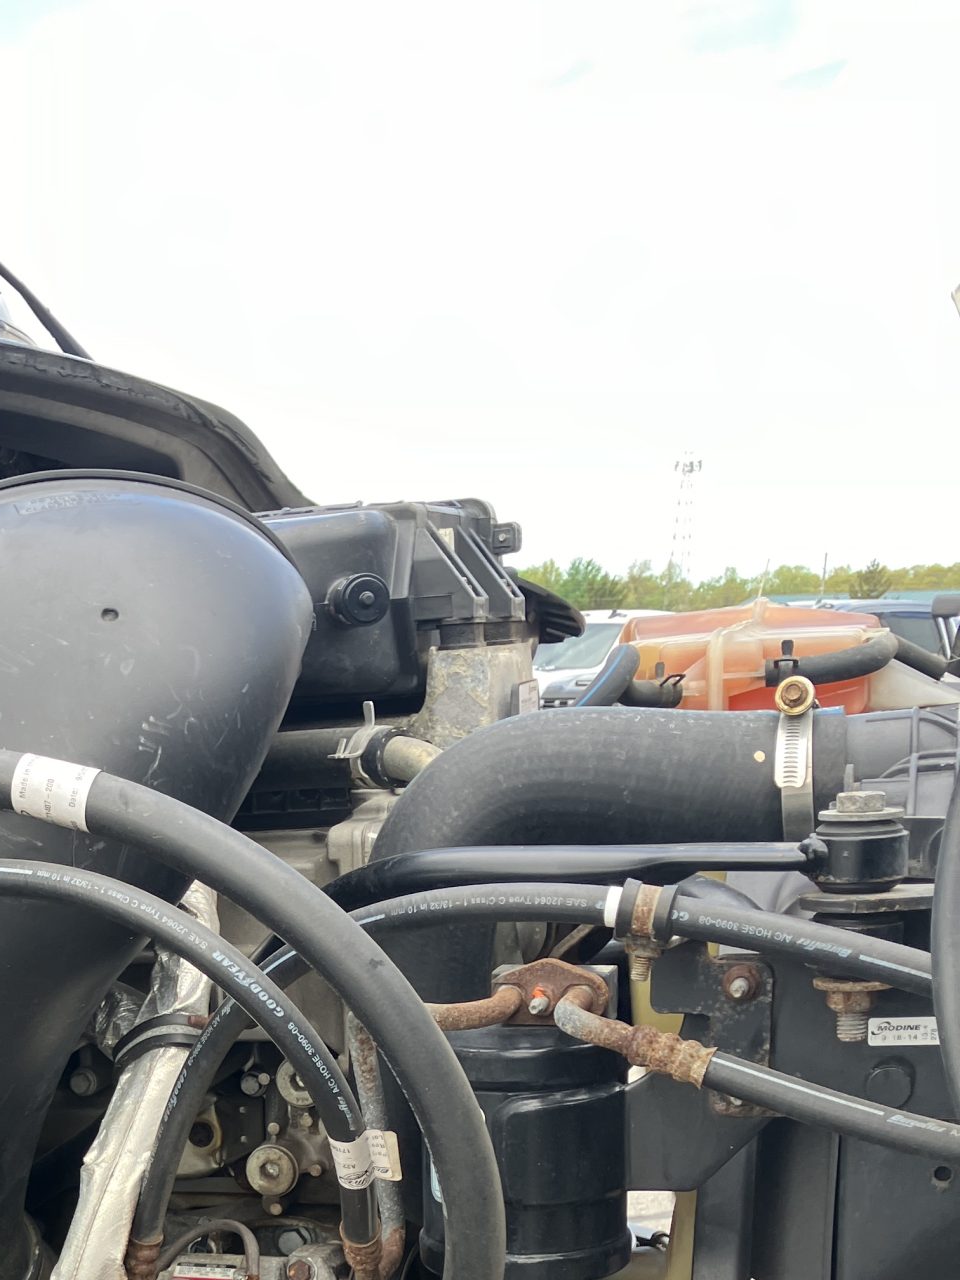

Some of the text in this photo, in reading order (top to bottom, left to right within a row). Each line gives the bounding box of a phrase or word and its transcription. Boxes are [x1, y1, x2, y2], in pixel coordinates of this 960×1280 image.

[131, 898, 139, 908] C
[140, 901, 163, 919] Type
[566, 898, 588, 908] SAE
[161, 916, 189, 935] J2064
[741, 922, 772, 940] HOSE
[189, 933, 208, 949] SAE
[774, 930, 793, 943] A/C
[212, 950, 285, 1018] GOODYEAR
[877, 1024, 921, 1033] MODINE
[312, 1054, 332, 1082] HOSE
